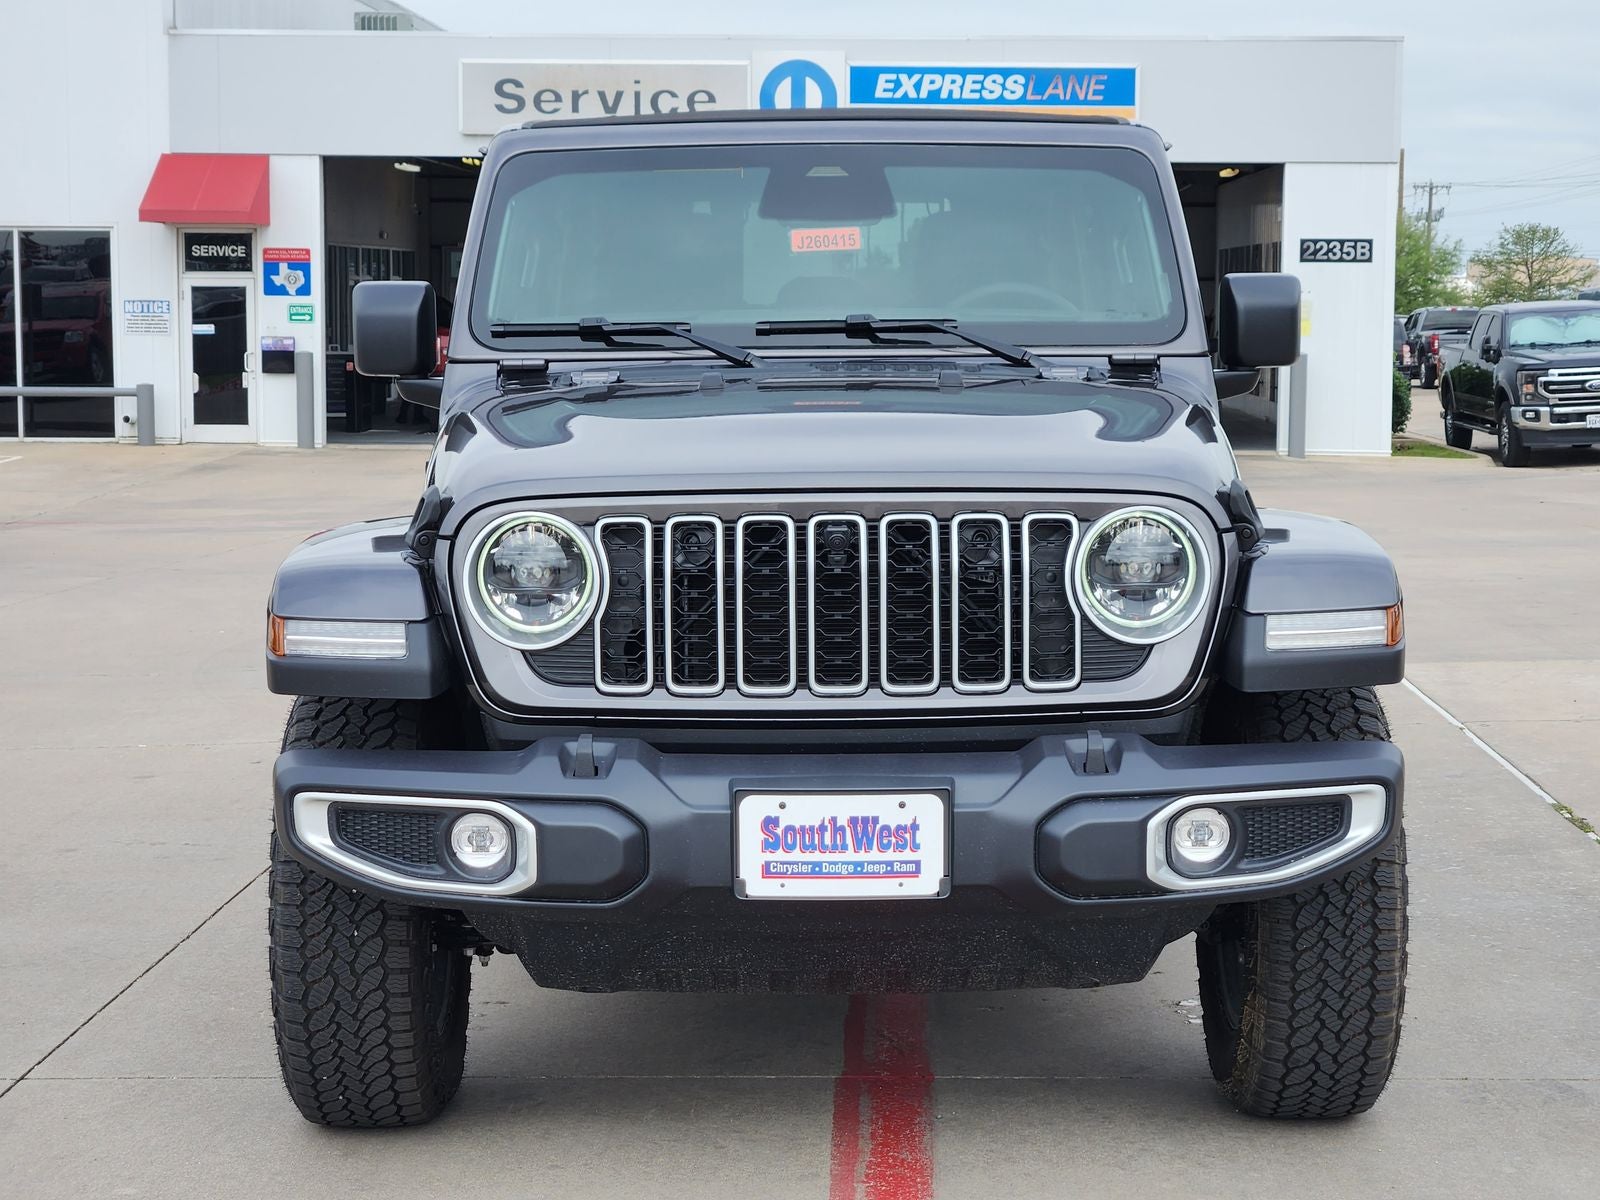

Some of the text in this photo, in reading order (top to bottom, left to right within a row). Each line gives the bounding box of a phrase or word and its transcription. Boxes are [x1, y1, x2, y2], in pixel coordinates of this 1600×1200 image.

[494, 78, 717, 116] Service
[797, 233, 856, 250] J260415
[191, 244, 246, 257] SERVICE
[1302, 241, 1371, 260] 2235B
[124, 301, 169, 313] NOTICE
[290, 306, 313, 314] ENTRANCE
[769, 861, 916, 874] Chrysler Dodge Jeep Ram
